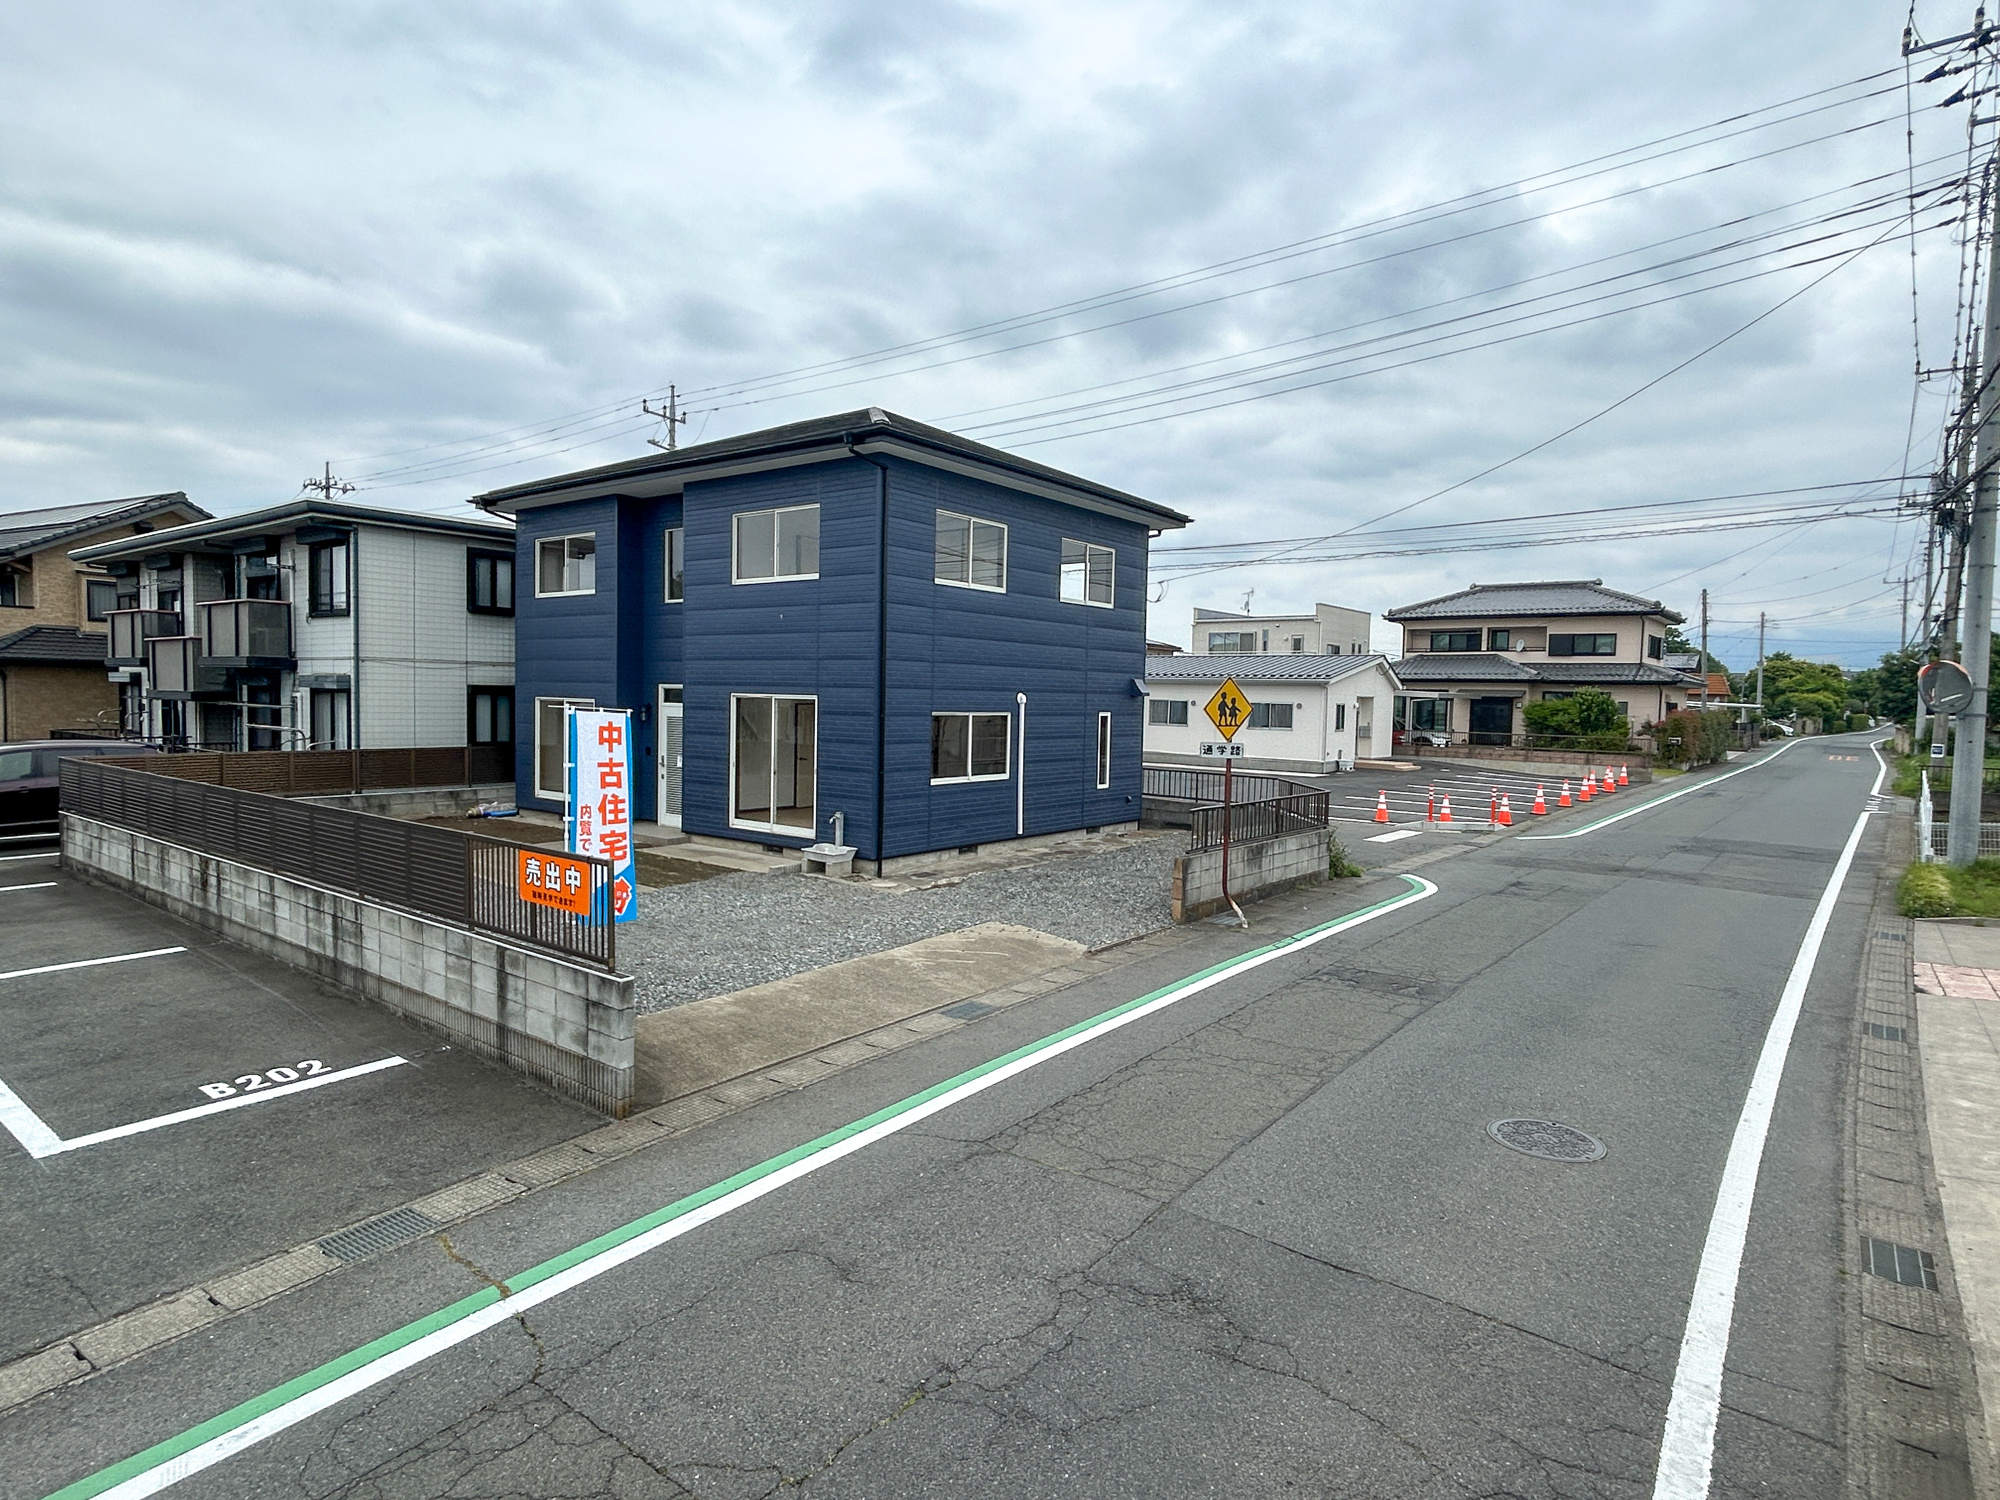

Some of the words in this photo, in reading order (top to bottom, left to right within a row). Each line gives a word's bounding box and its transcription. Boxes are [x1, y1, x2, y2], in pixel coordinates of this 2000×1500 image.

[1202, 744, 1241, 756] 通学路
[597, 721, 628, 861] 中古住宅
[579, 803, 594, 857] 内覧で
[525, 857, 582, 895] 売出中
[198, 1059, 333, 1100] B202
